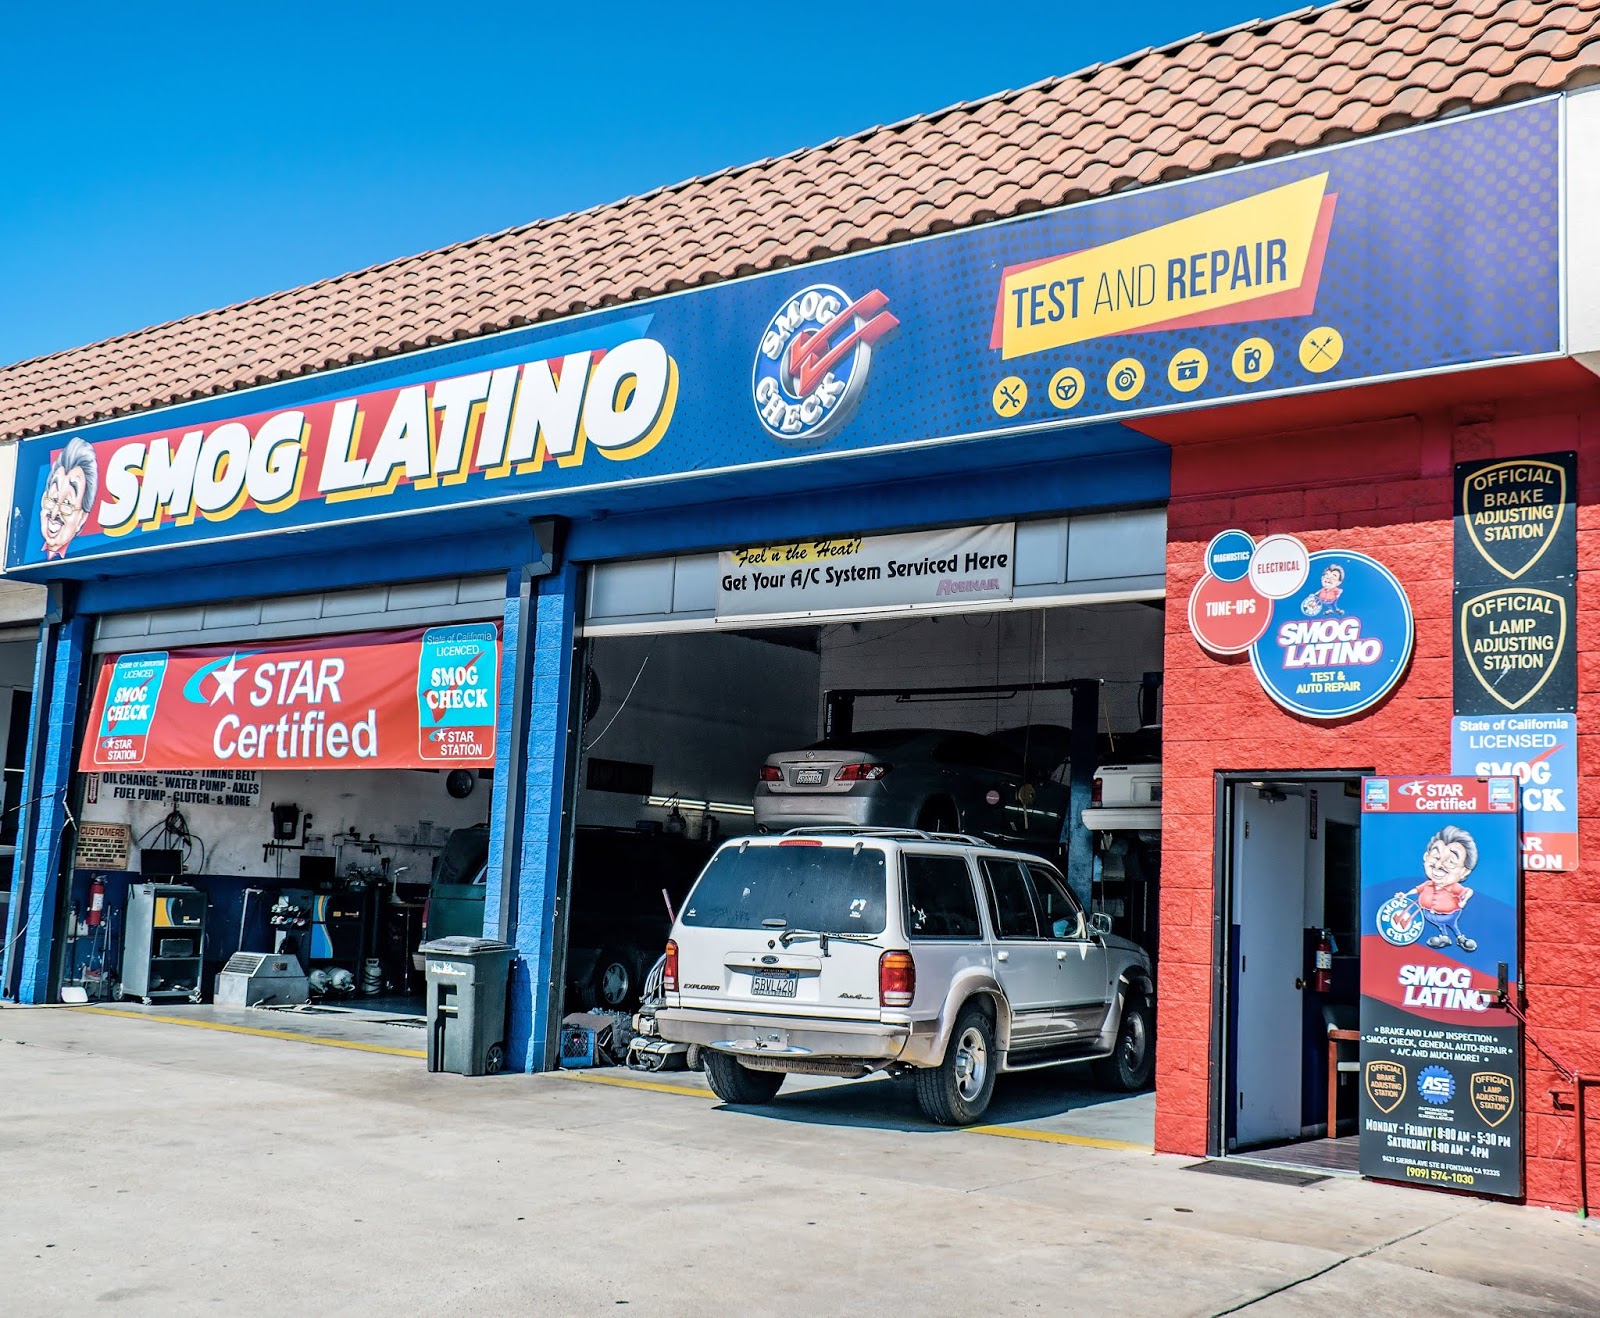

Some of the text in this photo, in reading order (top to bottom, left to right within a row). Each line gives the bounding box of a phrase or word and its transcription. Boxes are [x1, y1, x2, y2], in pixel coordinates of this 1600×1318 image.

[1012, 238, 1288, 329] TEST AND REPAIR
[762, 291, 841, 360] SMOG
[756, 372, 846, 432] CHECK
[100, 338, 673, 532] SMOG LATINO
[1474, 468, 1554, 490] OFFICIAL
[1484, 489, 1544, 507] BRAKE
[1474, 505, 1554, 525] ADJUSTING
[1484, 523, 1544, 542] STATION
[786, 543, 808, 561] the
[813, 537, 863, 558] Heat?
[1213, 551, 1250, 563] DIAGNOSTICS
[722, 553, 1008, 591] Get Your A/C System Serviced Here
[1257, 560, 1300, 574] ELECTRICAL
[936, 578, 999, 595] ROBINAIR
[1206, 599, 1256, 617] TUNE-UPS
[1471, 596, 1554, 618] OFFICIAL
[1279, 618, 1359, 646] SMOG
[1489, 619, 1536, 635] LAMP
[427, 631, 492, 645] State of California
[1474, 635, 1554, 654] ADJUSTING
[436, 645, 479, 656] LICENCED
[1285, 639, 1382, 667] LATINO
[1483, 654, 1543, 671] STATION
[250, 658, 345, 707] STAR
[430, 665, 478, 687] SMOG
[1311, 671, 1345, 682] TEST &
[114, 686, 148, 703] SMOG
[1296, 682, 1360, 694] AUTO REPAIR
[426, 688, 488, 709] CHECK
[107, 704, 150, 721] CHECK
[1459, 718, 1568, 732] State of California
[213, 709, 378, 759] Certified
[448, 731, 474, 742] STAR
[1469, 734, 1556, 748] LICENSED
[114, 739, 132, 749] STAR
[440, 744, 482, 755] STATION
[108, 750, 137, 760] STATION
[235, 771, 256, 781] BELT
[1475, 761, 1551, 784] SMOG
[103, 772, 118, 784] OIL
[119, 773, 158, 787] CHANGE
[165, 777, 197, 790] WATER
[199, 780, 226, 792] PUMP
[232, 783, 259, 794] AXLES
[1426, 784, 1463, 797] STAR
[114, 787, 136, 799] FUEL
[138, 789, 166, 801] PUMP
[173, 791, 209, 804] CLUTCH
[217, 795, 223, 804] &
[225, 795, 251, 806] MORE
[1415, 797, 1476, 810] Certified
[80, 827, 125, 837] CUSTOMERS
[1381, 899, 1408, 922] SMOG
[1386, 921, 1422, 941] CHECK
[755, 978, 794, 993] 5BVL420
[1399, 965, 1471, 989] SMOG
[683, 983, 720, 991] EXPLORER
[1403, 986, 1491, 1011] LATINO
[1380, 1026, 1492, 1043] BRAKE AND LAMP INSPECTION
[1366, 1035, 1508, 1055] SMOG CHECK, GENERAL AUTO-REPAIR
[1397, 1048, 1480, 1063] A/C AND MUCH MORE!
[1370, 1064, 1401, 1075] OFFICIAL
[1376, 1074, 1396, 1082] BRAKE
[1370, 1081, 1402, 1090] ADJUSTING
[1421, 1076, 1450, 1091] ASE
[1475, 1075, 1509, 1087] OFFICIAL
[1374, 1089, 1398, 1098] STATION
[1476, 1093, 1509, 1103] ADJUSTING
[1480, 1101, 1505, 1110] STATION
[1437, 1127, 1456, 1140] 8:00
[1457, 1131, 1470, 1142] AM
[1477, 1131, 1497, 1145] 5:30
[1498, 1136, 1511, 1147] PM
[1431, 1140, 1449, 1153] 8:00
[1450, 1144, 1463, 1155] AM
[1396, 1157, 1416, 1165] SIERRA
[1446, 1164, 1473, 1173] FONTANA
[1406, 1166, 1474, 1184] (909) 574-1030
